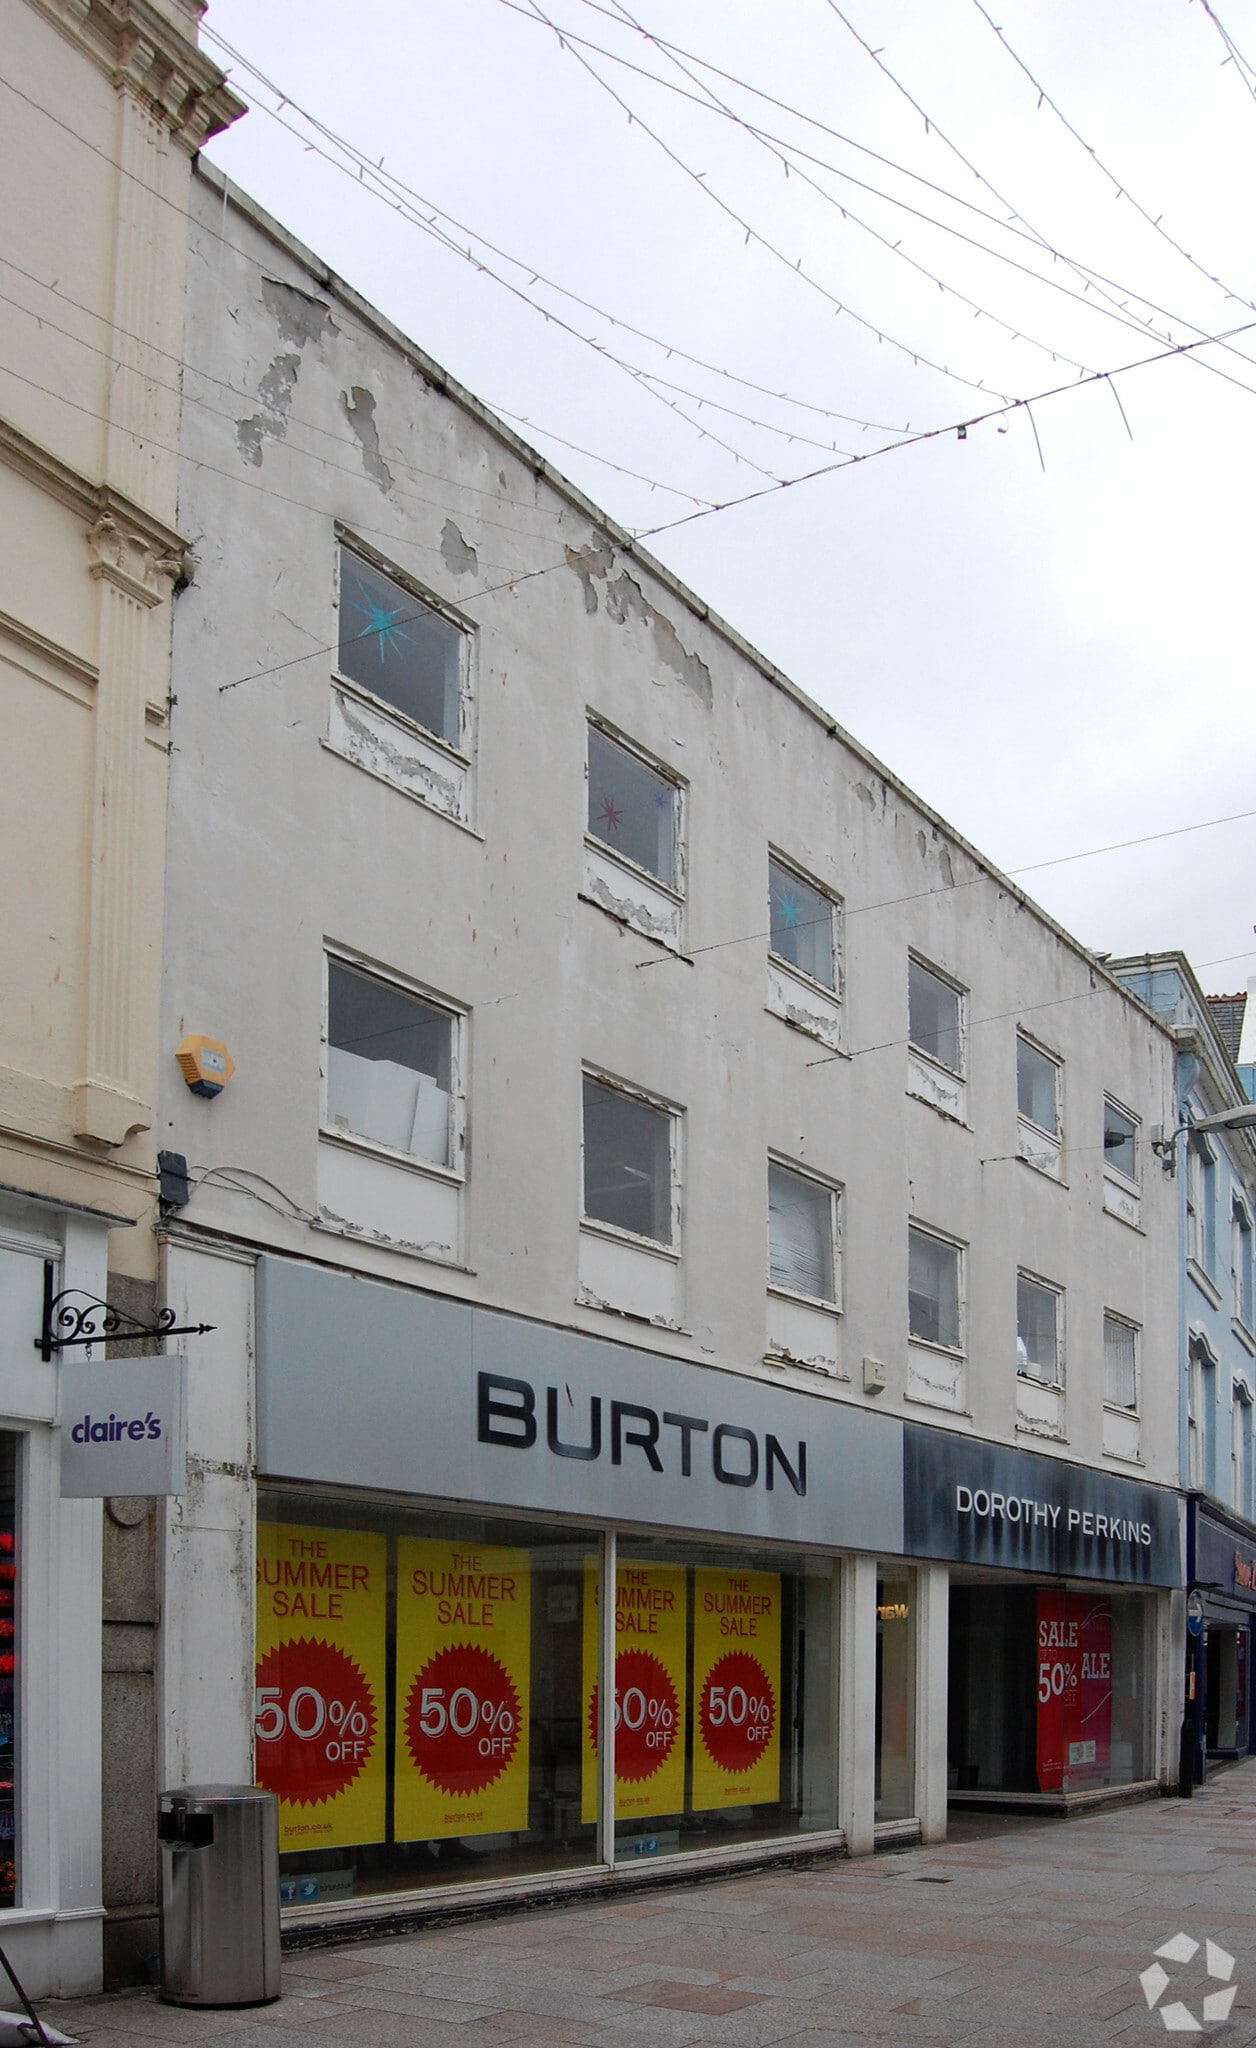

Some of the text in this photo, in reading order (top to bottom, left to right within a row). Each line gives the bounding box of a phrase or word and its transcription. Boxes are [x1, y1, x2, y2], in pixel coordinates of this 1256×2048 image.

[71, 1412, 161, 1443] claire's
[478, 1371, 807, 1496] BURTON
[956, 1485, 1151, 1545] DOROTHY PERKINS
[288, 1538, 328, 1558] THE
[452, 1553, 482, 1571] THE
[412, 1570, 516, 1600] SUMMER
[624, 1570, 648, 1585] THE
[728, 1579, 749, 1592] THE
[272, 1590, 343, 1618] SALE
[438, 1600, 494, 1626] SALE
[703, 1592, 771, 1616] SUMMER
[615, 1612, 657, 1633] SALE
[720, 1617, 757, 1636] SALE
[1039, 1620, 1078, 1647] SALE
[1038, 1663, 1077, 1703] 50%
[255, 1686, 368, 1742] 50%
[420, 1687, 514, 1738] 50%
[709, 1686, 770, 1727] 50%
[646, 1731, 671, 1747] OFF
[747, 1726, 768, 1741] OFF
[325, 1741, 365, 1761] OFF
[478, 1738, 511, 1756] OFF
